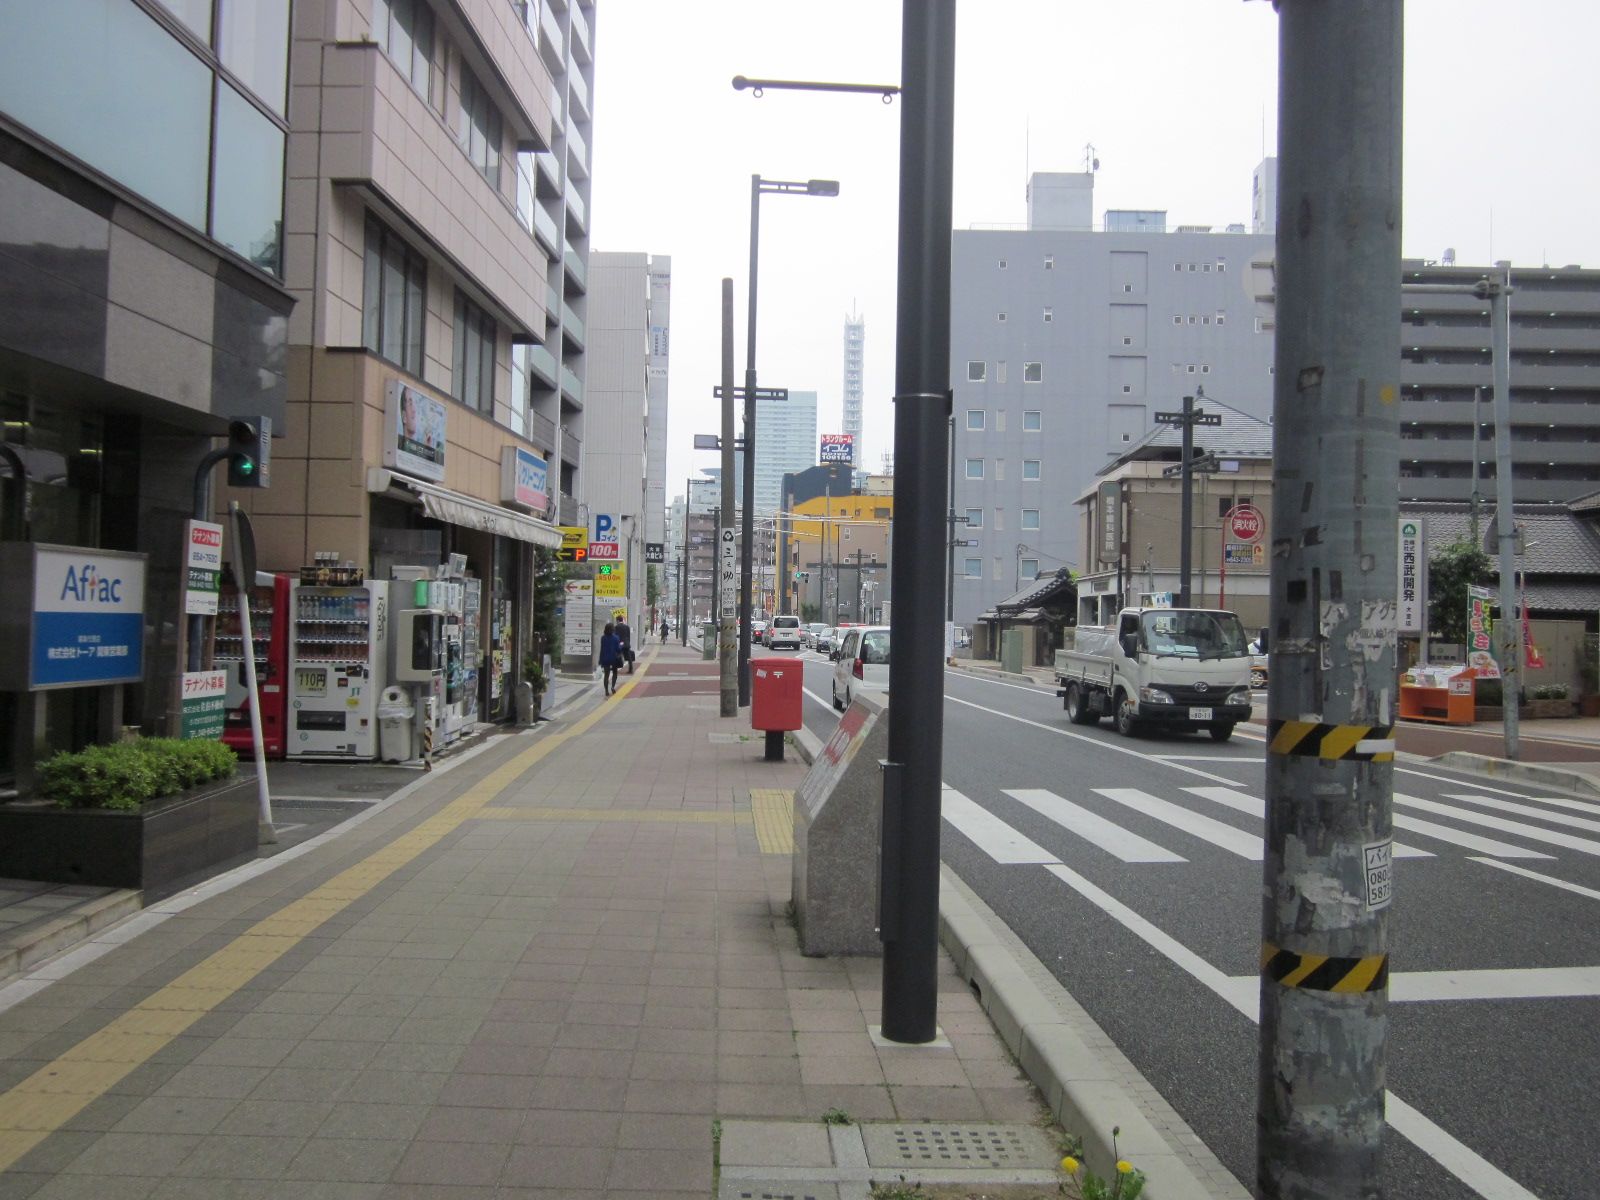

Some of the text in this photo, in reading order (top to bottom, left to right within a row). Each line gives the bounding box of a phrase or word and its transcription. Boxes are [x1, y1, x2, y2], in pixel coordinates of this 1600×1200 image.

[596, 514, 612, 541] P
[1233, 519, 1258, 531] 消火栓
[576, 550, 585, 560] P
[61, 564, 122, 602] Aflac
[1404, 553, 1415, 601] 西武開発
